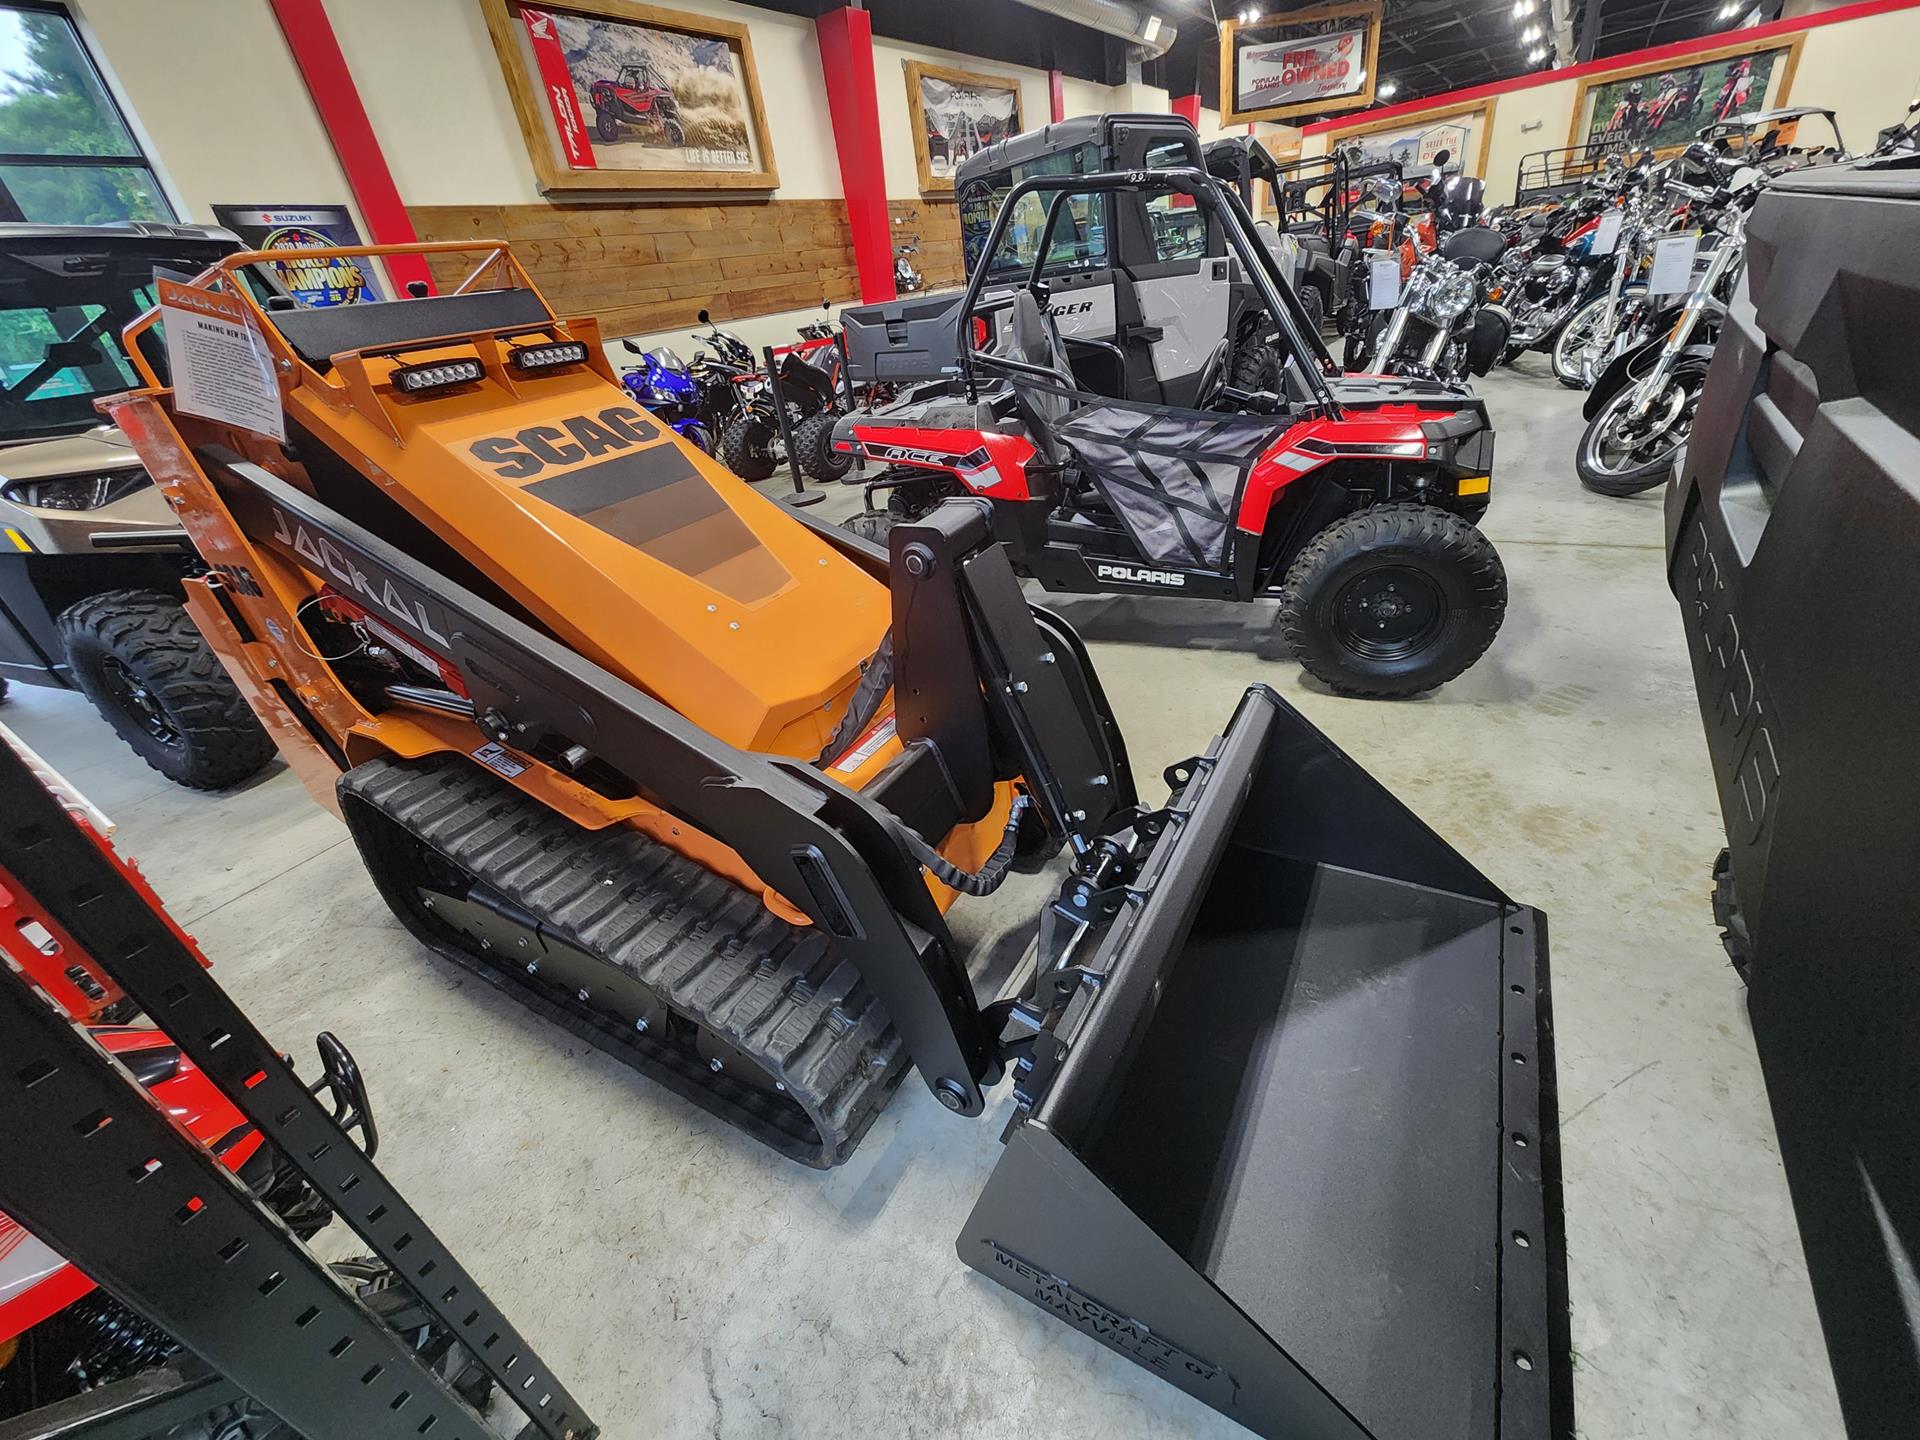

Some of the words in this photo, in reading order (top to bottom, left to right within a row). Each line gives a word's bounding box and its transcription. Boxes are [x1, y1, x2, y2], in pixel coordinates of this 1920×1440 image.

[1251, 75, 1281, 86] POPULAR
[1281, 60, 1350, 86] OWNED
[552, 85, 580, 160] TALON
[1589, 129, 1632, 144] EVERY
[1422, 147, 1457, 160] DES
[168, 289, 241, 318] JACKAL
[197, 321, 225, 335] MAKING
[226, 329, 239, 339] NEW
[468, 406, 661, 479] SCAG
[272, 507, 451, 650] JACKAL
[1098, 565, 1185, 586] POLARIS
[995, 1251, 1179, 1357] METALCRAFT
[1034, 1288, 1170, 1372] MAYVILLE
